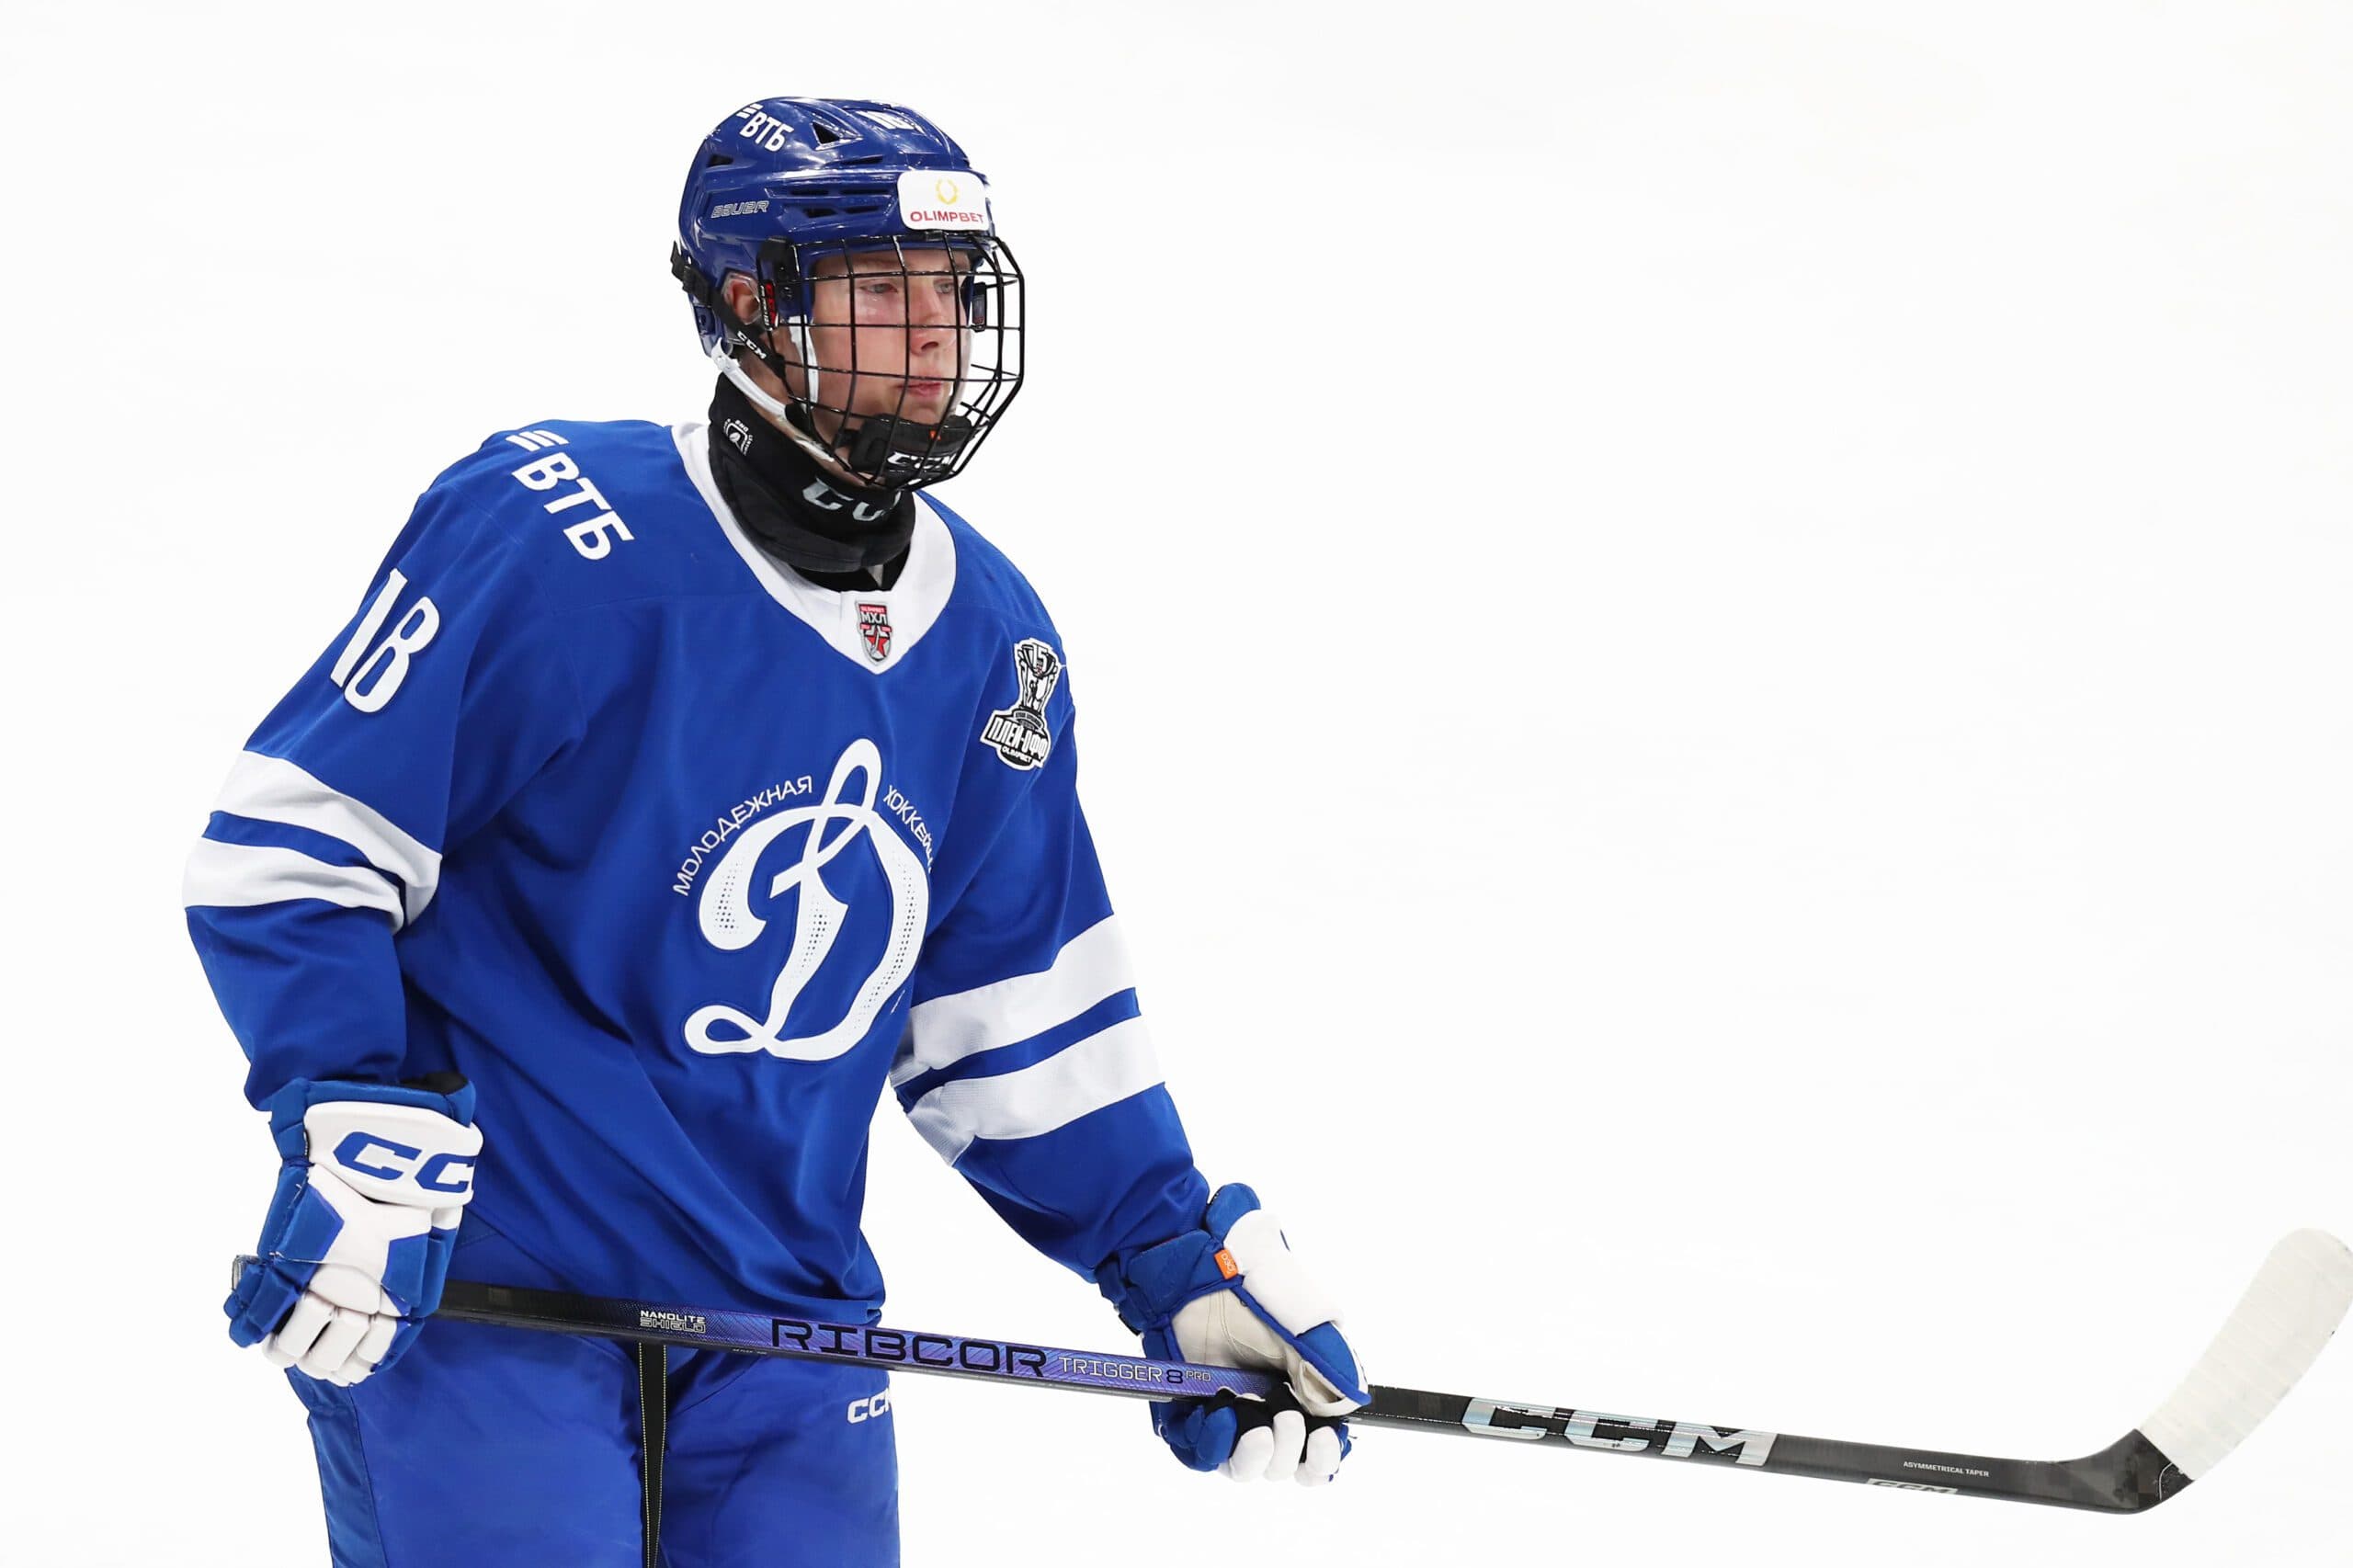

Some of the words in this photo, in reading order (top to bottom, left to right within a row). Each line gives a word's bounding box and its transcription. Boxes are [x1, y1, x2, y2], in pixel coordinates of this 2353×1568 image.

[739, 111, 794, 152] ВТБ
[711, 200, 769, 219] BAUER
[910, 210, 983, 223] OLIMPBET
[512, 451, 635, 560] ВТБ
[330, 567, 440, 713] 18
[673, 775, 813, 897] МОЛОДЕЖНАЯ
[640, 1310, 706, 1324] NANOLITE
[640, 1317, 706, 1333] SHIELD
[772, 1319, 1046, 1377] RIBCOR
[1059, 1357, 1163, 1382] TRIGGER
[1166, 1369, 1183, 1384] 8
[1186, 1370, 1211, 1381] PRO
[1461, 1397, 1778, 1467] CCM
[1904, 1460, 1964, 1474] ASYMMETRICAL
[1965, 1468, 1990, 1478] TAPER
